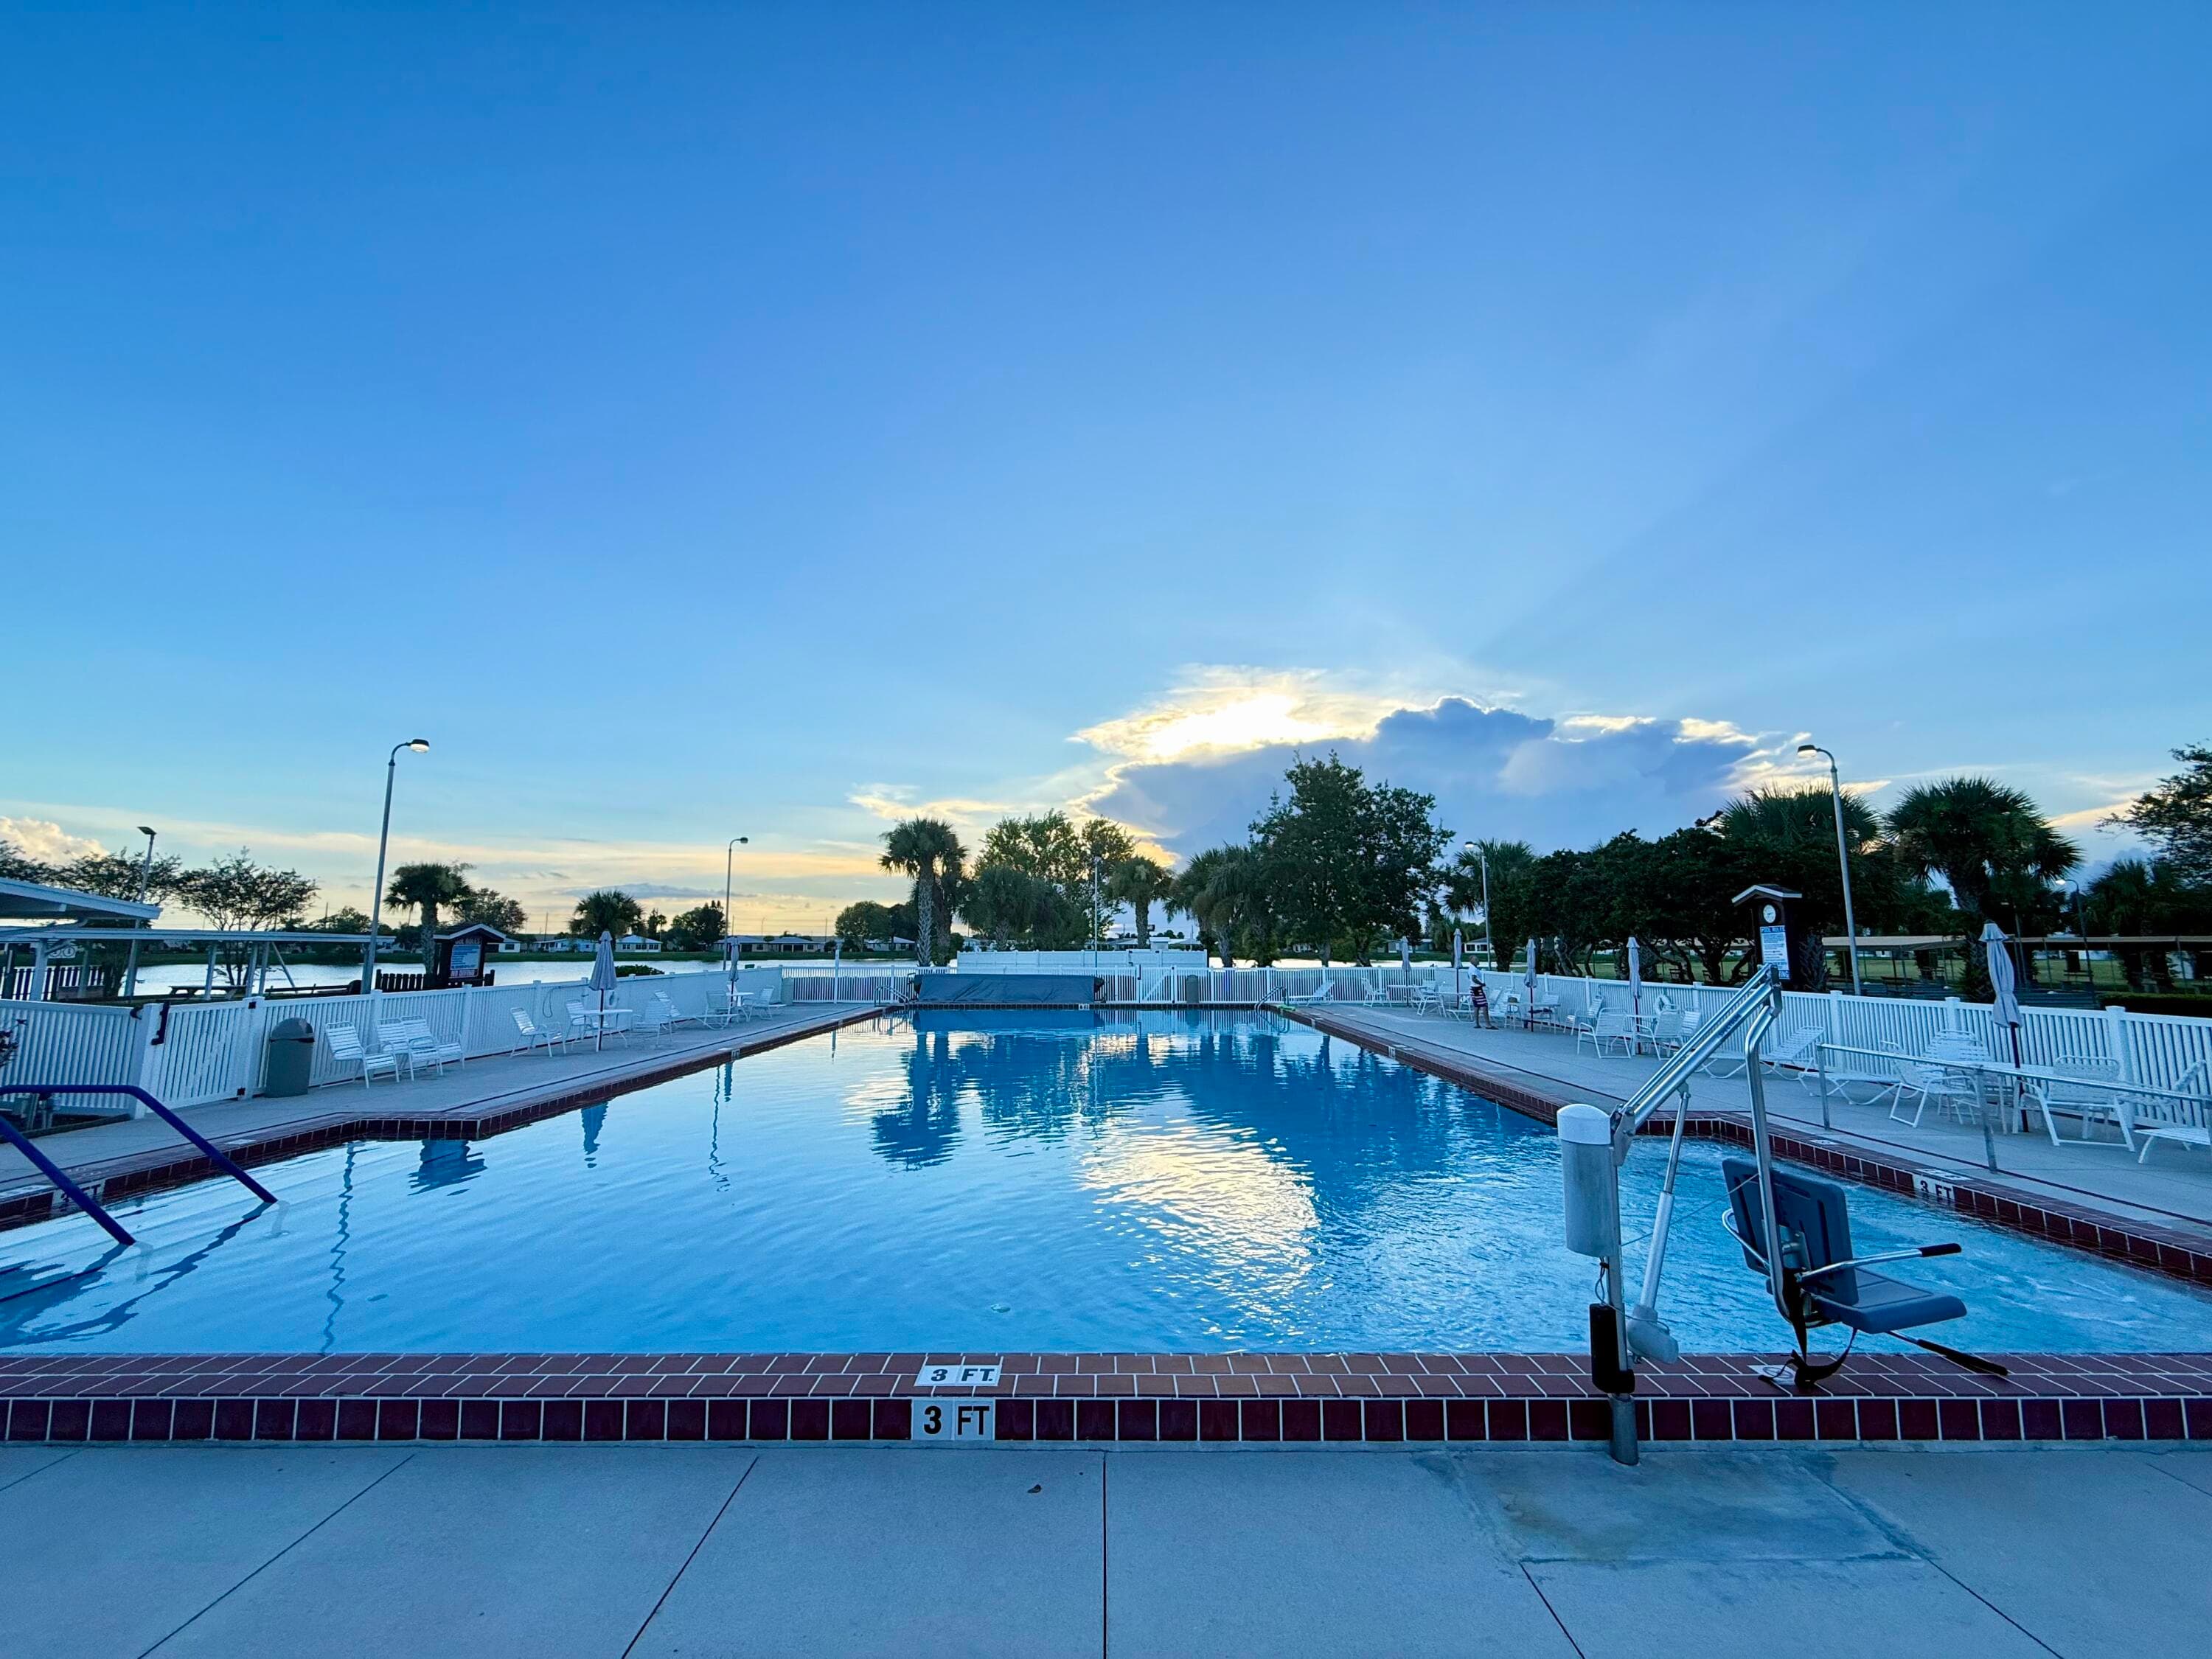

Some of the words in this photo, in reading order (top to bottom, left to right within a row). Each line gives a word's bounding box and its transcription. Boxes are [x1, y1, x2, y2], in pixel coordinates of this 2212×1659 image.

[1920, 1180, 1930, 1194] 3
[1935, 1183, 1952, 1200] FT
[931, 1368, 948, 1382] 3
[961, 1368, 995, 1382] FT.
[923, 1405, 942, 1435] 3
[958, 1405, 990, 1435] FT
